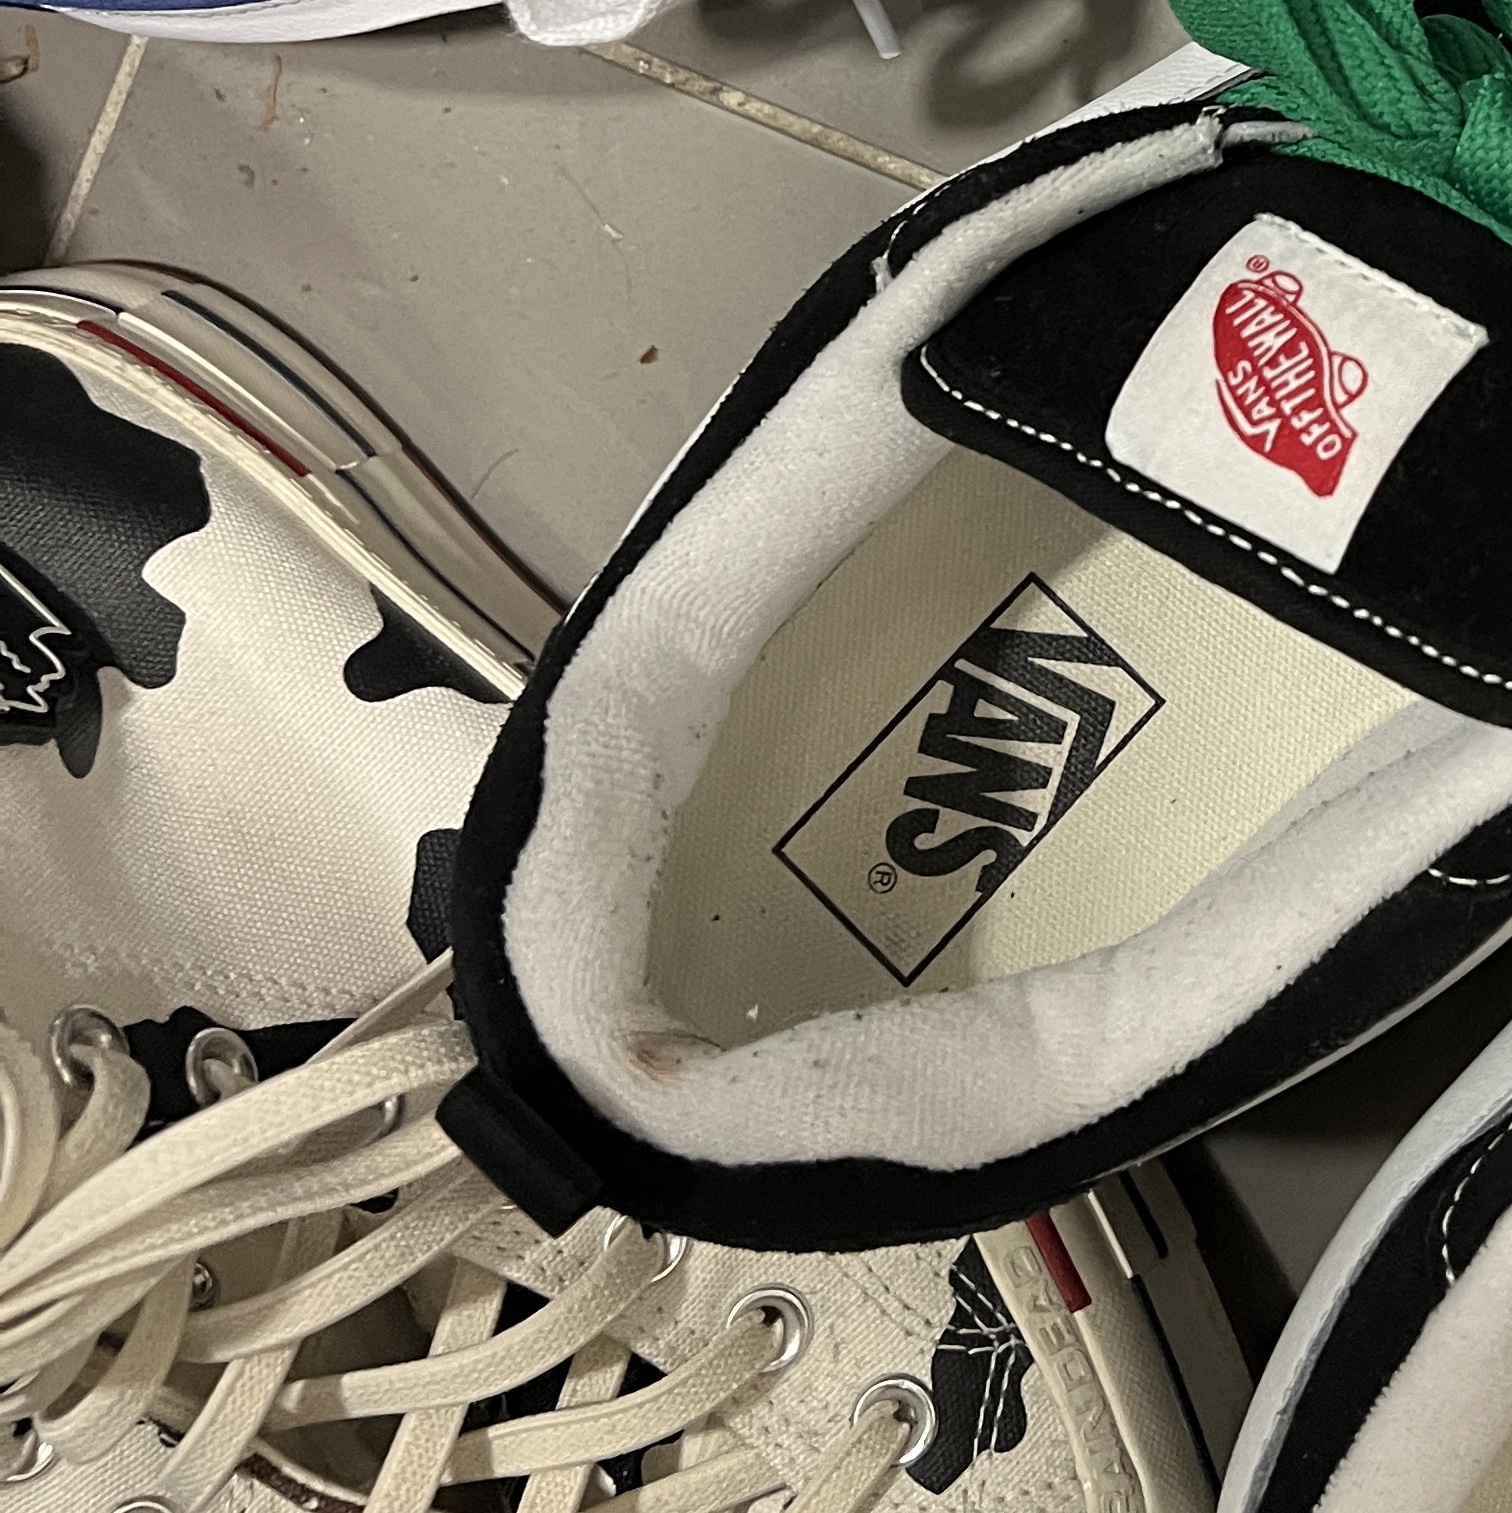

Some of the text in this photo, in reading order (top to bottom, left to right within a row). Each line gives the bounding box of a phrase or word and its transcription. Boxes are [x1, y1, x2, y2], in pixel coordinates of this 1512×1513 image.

[1218, 359, 1283, 453] VANS
[1224, 290, 1342, 460] OFF THE WALL
[886, 626, 1126, 894] VANS
